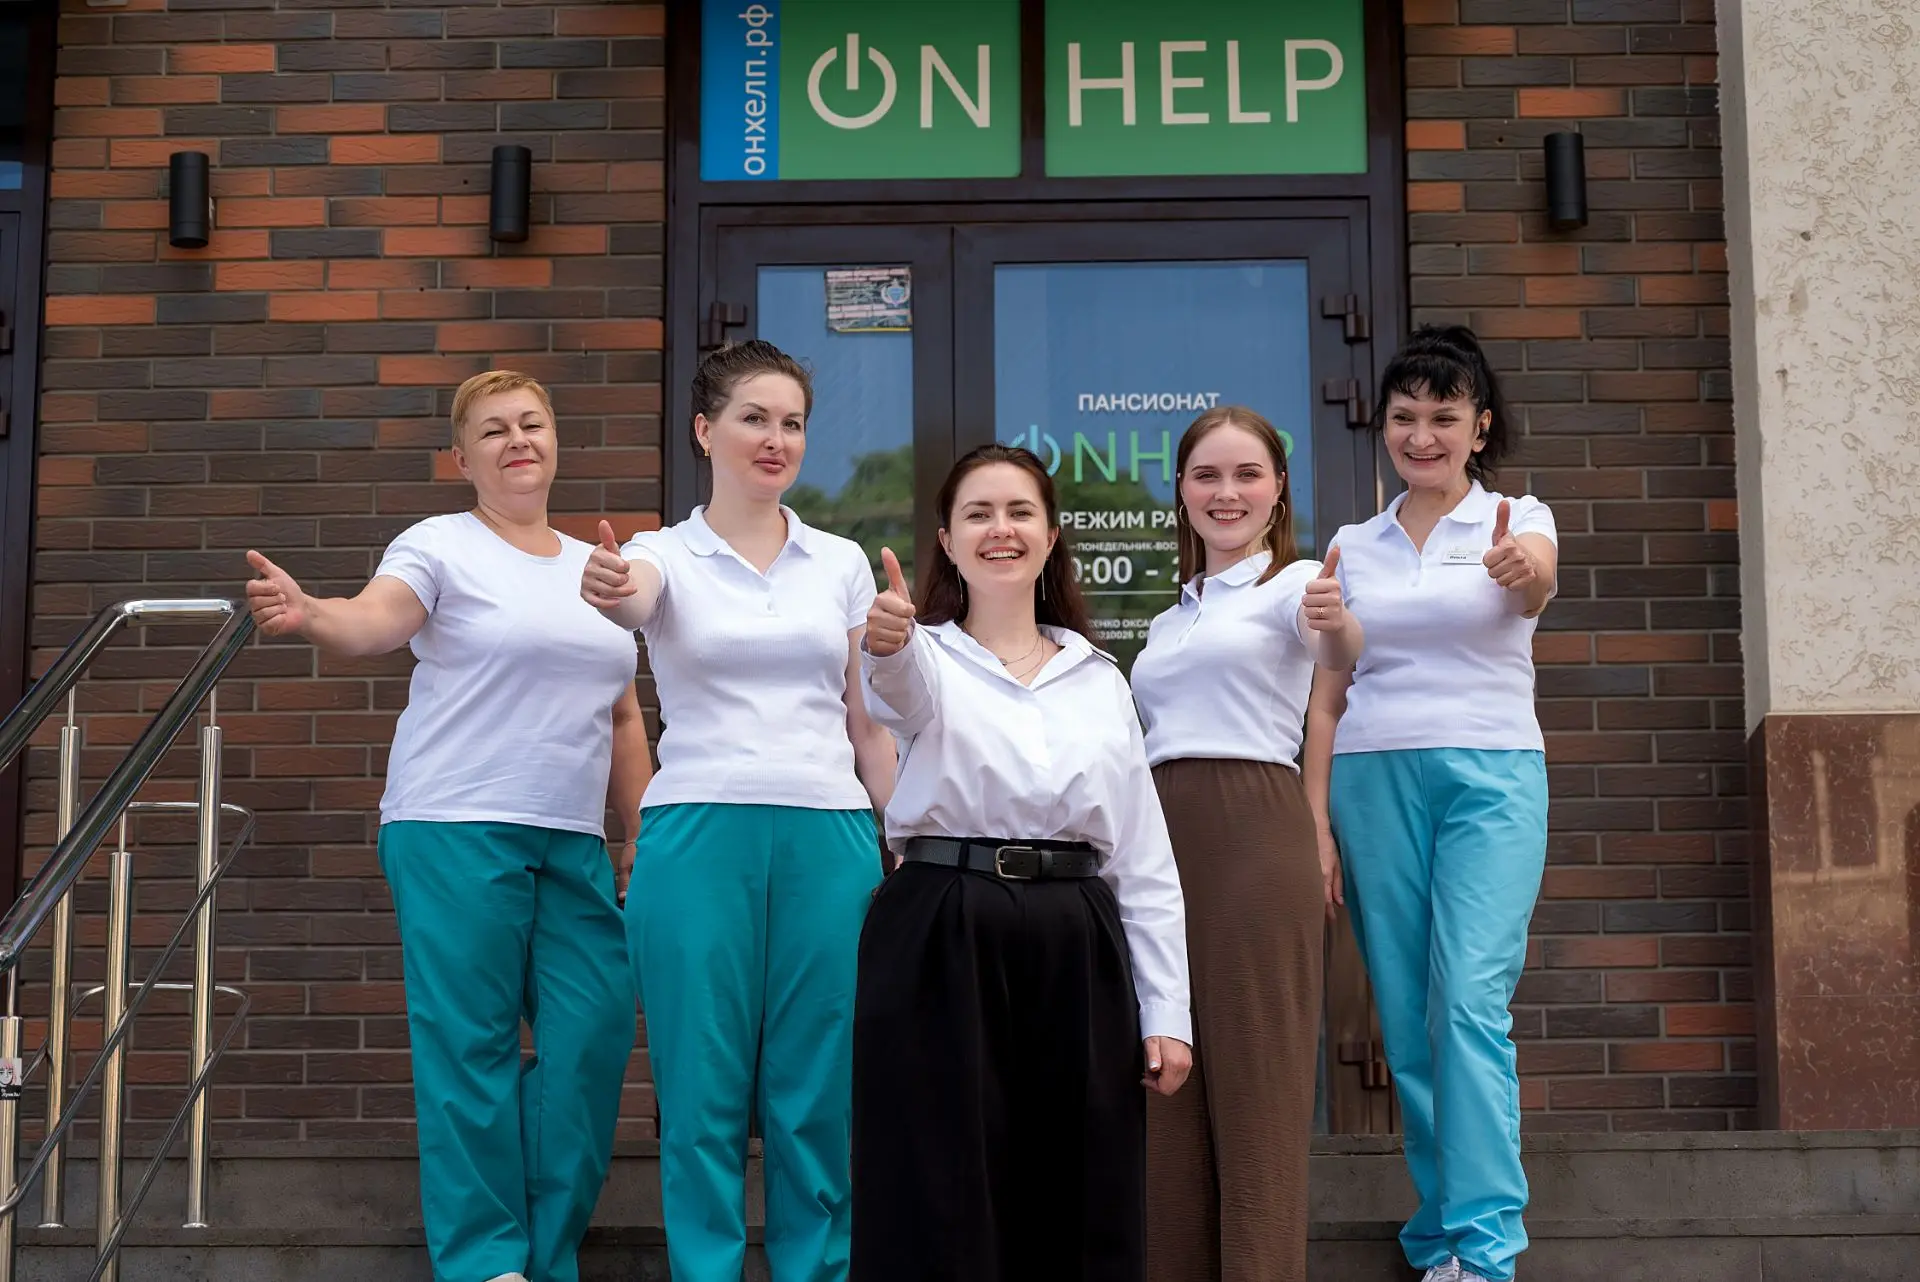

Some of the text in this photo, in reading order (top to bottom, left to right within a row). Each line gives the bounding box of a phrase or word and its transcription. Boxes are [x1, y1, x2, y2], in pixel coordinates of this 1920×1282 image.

[738, 4, 774, 176] онхелп.рф
[807, 33, 1344, 129] ON HELP
[1078, 392, 1221, 412] ПАНСИОНАТ
[1059, 510, 1178, 530] РЕЖИМ РА
[1077, 541, 1178, 552] ПОНЕДЕЛЬНИК-ВОС
